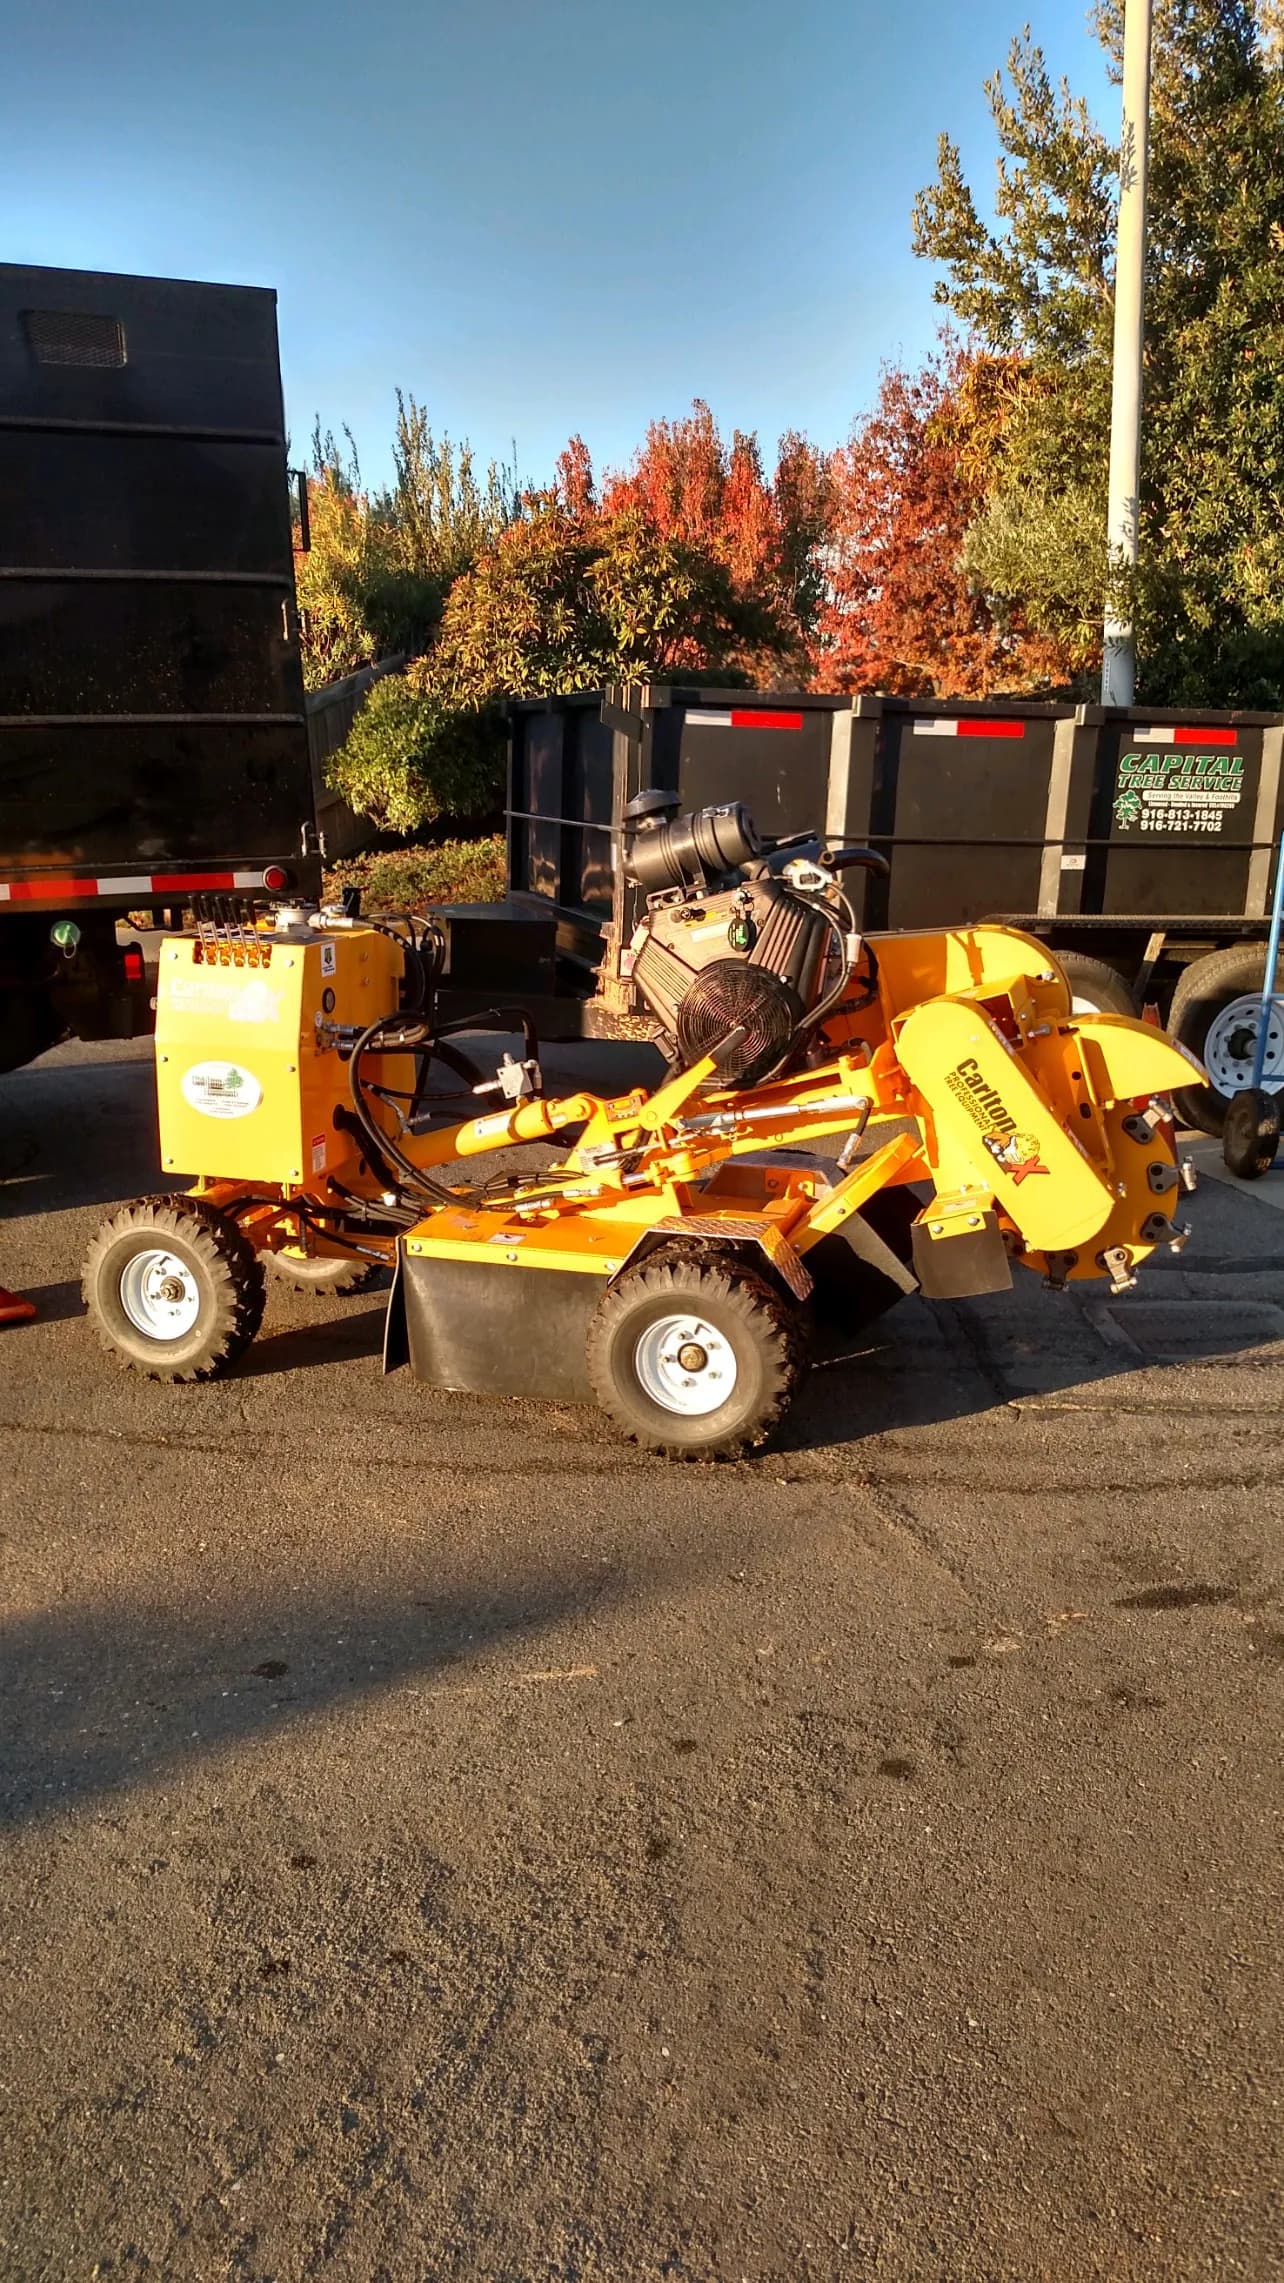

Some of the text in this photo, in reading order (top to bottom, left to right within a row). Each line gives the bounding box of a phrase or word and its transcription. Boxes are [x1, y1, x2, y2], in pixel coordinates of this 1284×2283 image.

[1119, 753, 1245, 776] CAPITAL
[1117, 773, 1243, 791] TREE SERVICE
[1148, 791, 1172, 800] Serving
[1185, 793, 1204, 801] Valley
[1141, 809, 1223, 820] 916-813-1845
[1140, 820, 1222, 832] 916-721-7702
[944, 1075, 989, 1131] TREE EQUIPMENT
[949, 1071, 997, 1130] PROFESSIONAL
[956, 1057, 1017, 1133] Carlton
